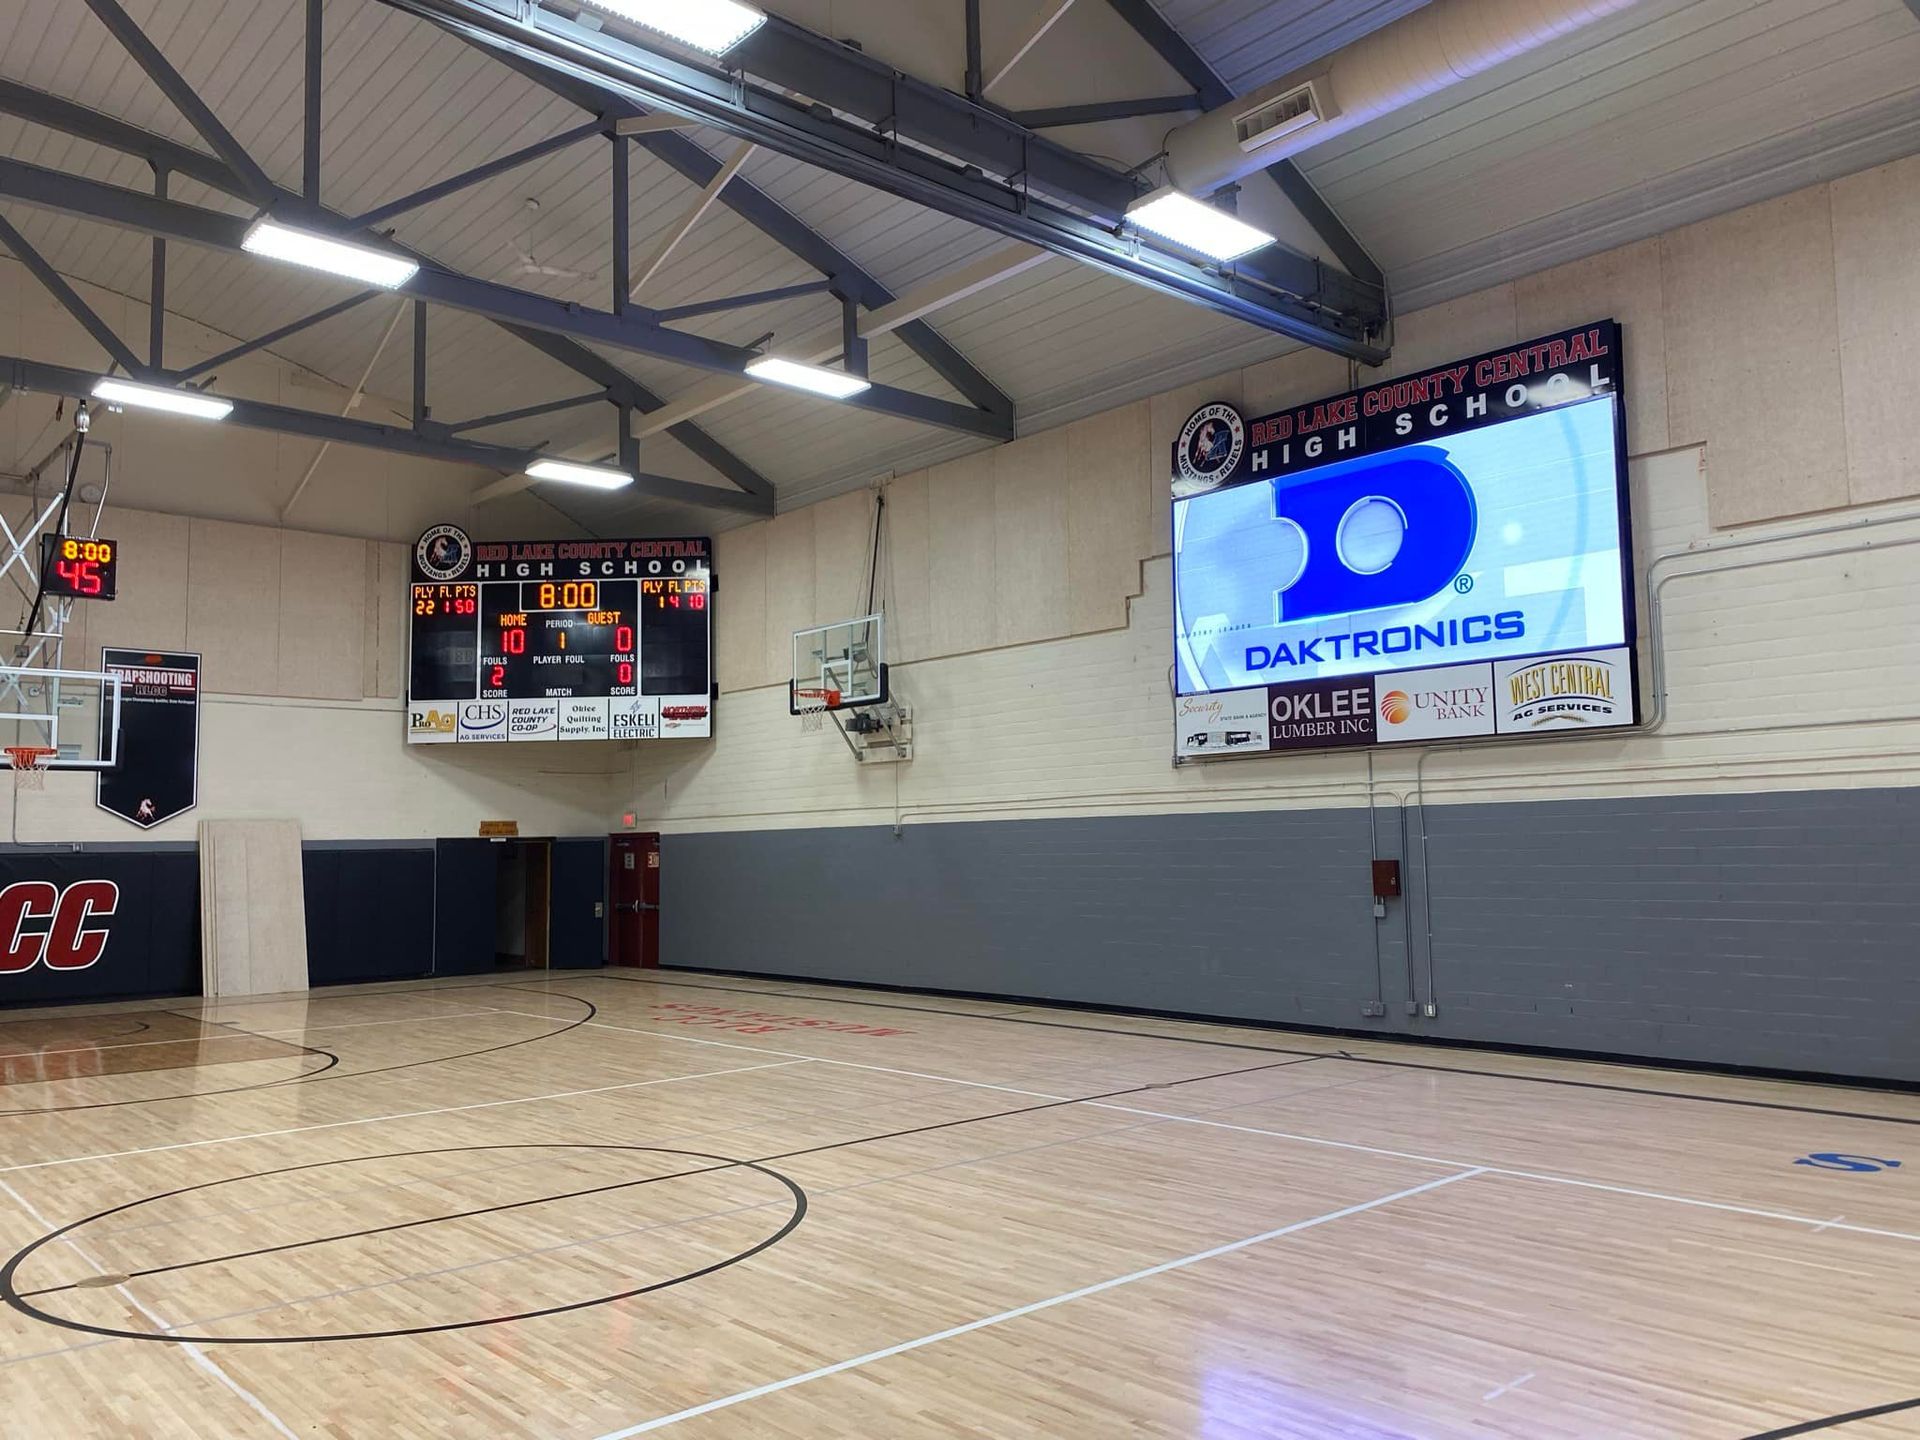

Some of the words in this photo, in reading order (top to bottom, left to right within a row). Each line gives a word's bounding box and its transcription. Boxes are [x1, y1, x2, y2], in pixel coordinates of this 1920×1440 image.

[1252, 415, 1293, 447] RED
[1298, 396, 1359, 434] LAKE
[1363, 366, 1469, 416] COUNTY
[1475, 329, 1608, 387] CENTRAL
[1185, 410, 1208, 437] HOME
[1208, 407, 1221, 416] OF
[1221, 408, 1237, 425] THE
[1252, 426, 1357, 472] HIGH
[1395, 363, 1610, 435] SCHOOL
[1219, 439, 1242, 477] REBELS
[422, 528, 441, 544] HOME
[453, 530, 466, 541] THE
[64, 540, 111, 563] 8:00
[477, 545, 509, 561] RED
[512, 544, 555, 560] LAKE
[558, 542, 628, 559] COUNTY
[630, 541, 706, 558] CENTRAL
[57, 560, 101, 593] 45
[476, 563, 553, 577] HIGH
[415, 586, 434, 598] PLY
[455, 585, 476, 597] PTS
[643, 581, 663, 593] PLY
[668, 581, 681, 592] FL
[684, 580, 706, 592] PTS
[540, 583, 595, 608] 8:00
[669, 596, 679, 608] 4
[689, 595, 704, 608] 10
[416, 601, 435, 614] 22
[455, 600, 474, 613] 50
[500, 614, 527, 626] HOME
[546, 620, 573, 628] PERIOD
[587, 611, 621, 624] GUEST
[503, 629, 525, 654] 10
[559, 632, 566, 649] 1
[616, 626, 632, 652] 0
[1245, 610, 1526, 672] DAKTRONICS
[483, 657, 507, 665] FOULS
[533, 656, 561, 664] PLAYER
[565, 655, 585, 663] FOUL
[610, 654, 635, 662] FOULS
[492, 666, 504, 686] 2
[618, 663, 632, 684] 0
[610, 687, 636, 696] SCORE
[1510, 667, 1546, 705] WEST
[1550, 663, 1614, 699] CENTRAL
[482, 689, 508, 698] SCORE
[545, 688, 572, 697] MATCH
[1413, 687, 1489, 709] UNITY
[465, 704, 502, 720] CHS
[1271, 687, 1370, 722] OKLEE
[1437, 704, 1485, 720] BANK
[1513, 709, 1534, 721] AG
[1537, 703, 1613, 714] SERVICES
[511, 716, 548, 724] COUNTY
[566, 715, 602, 724] Quilting
[613, 713, 655, 727] ESKELI
[511, 724, 538, 732] CO-OP
[613, 728, 655, 738] ELECTRIC
[1272, 720, 1336, 739] LUMBER
[1340, 718, 1373, 734] INC.
[1792, 1153, 1902, 1172] S
